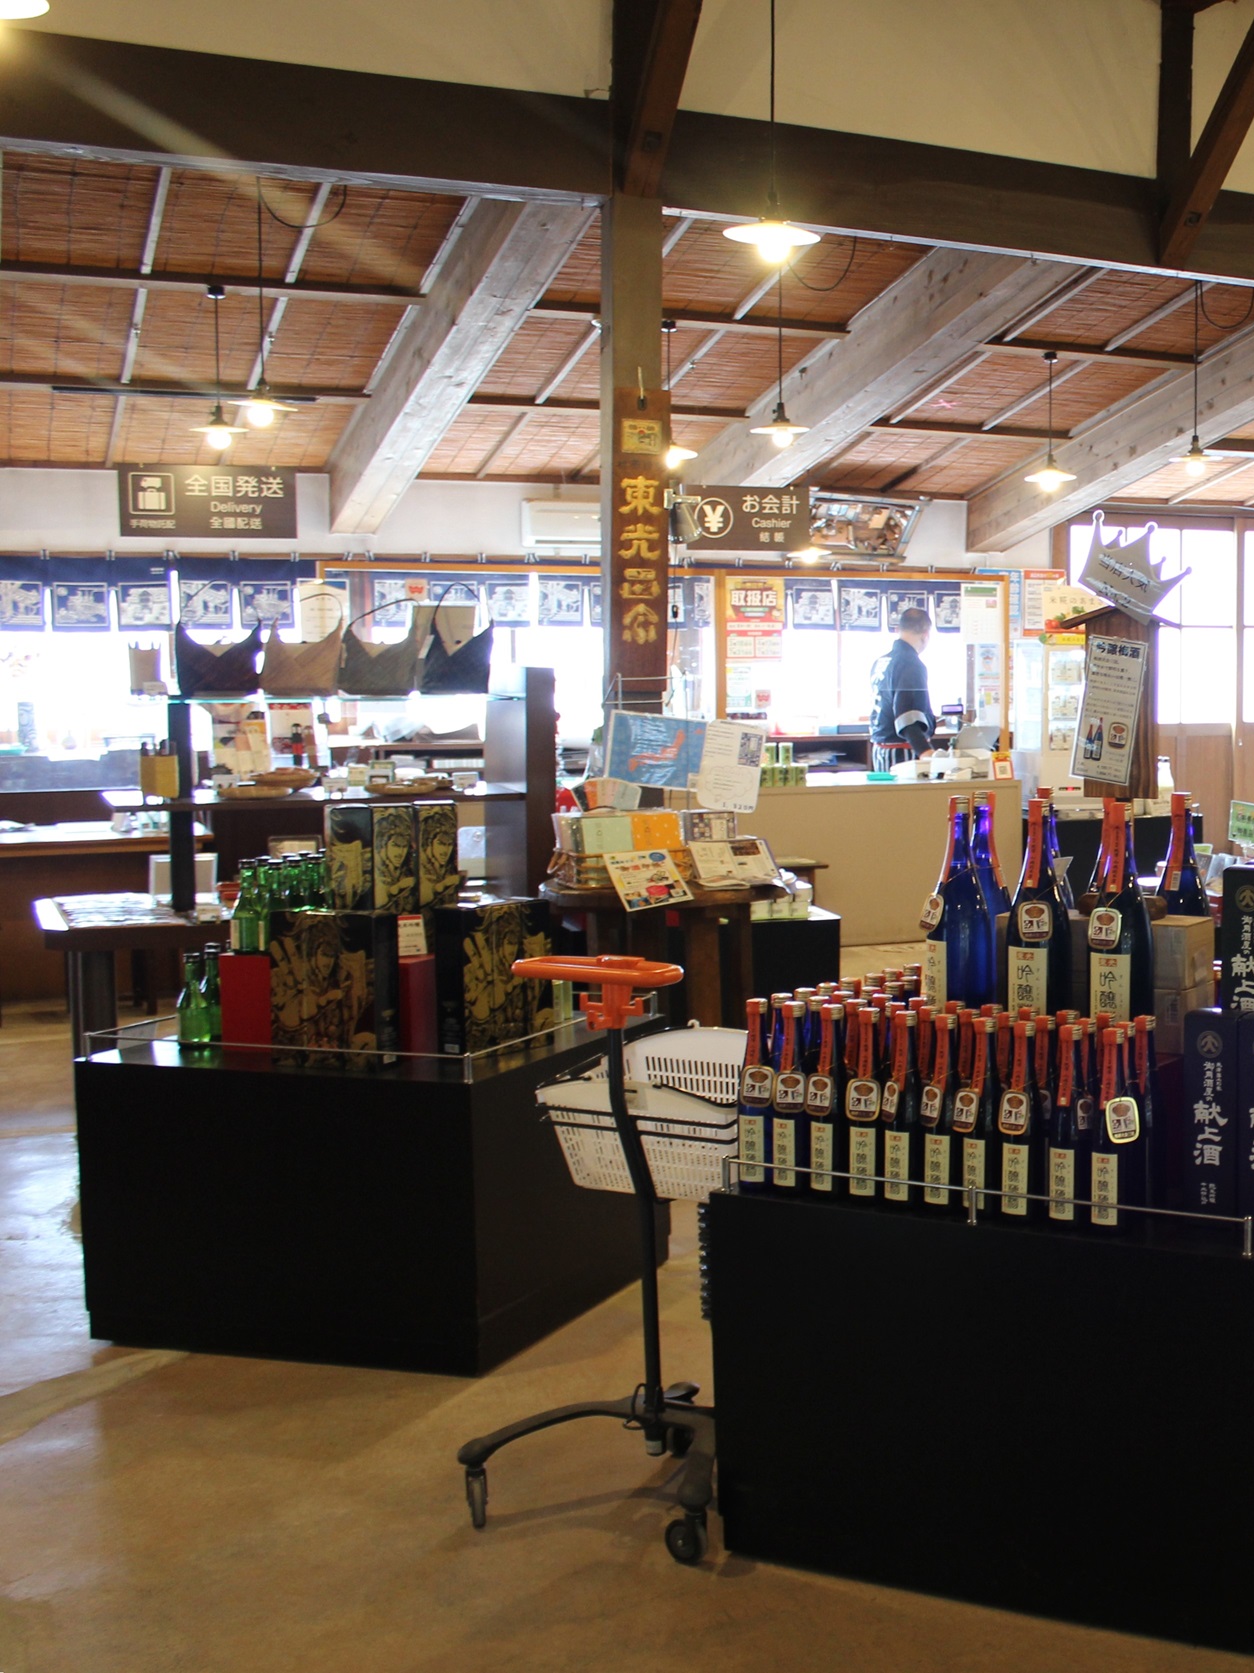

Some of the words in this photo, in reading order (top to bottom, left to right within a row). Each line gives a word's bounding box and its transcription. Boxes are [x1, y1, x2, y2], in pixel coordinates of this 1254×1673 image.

[184, 474, 284, 498] 全国発送
[210, 501, 262, 515] Delivery
[741, 494, 800, 515] お会計
[210, 516, 262, 530] 全國配送
[752, 518, 792, 529] Cashier
[730, 590, 778, 606] 取扱店
[1193, 1100, 1228, 1166] 献上酒
